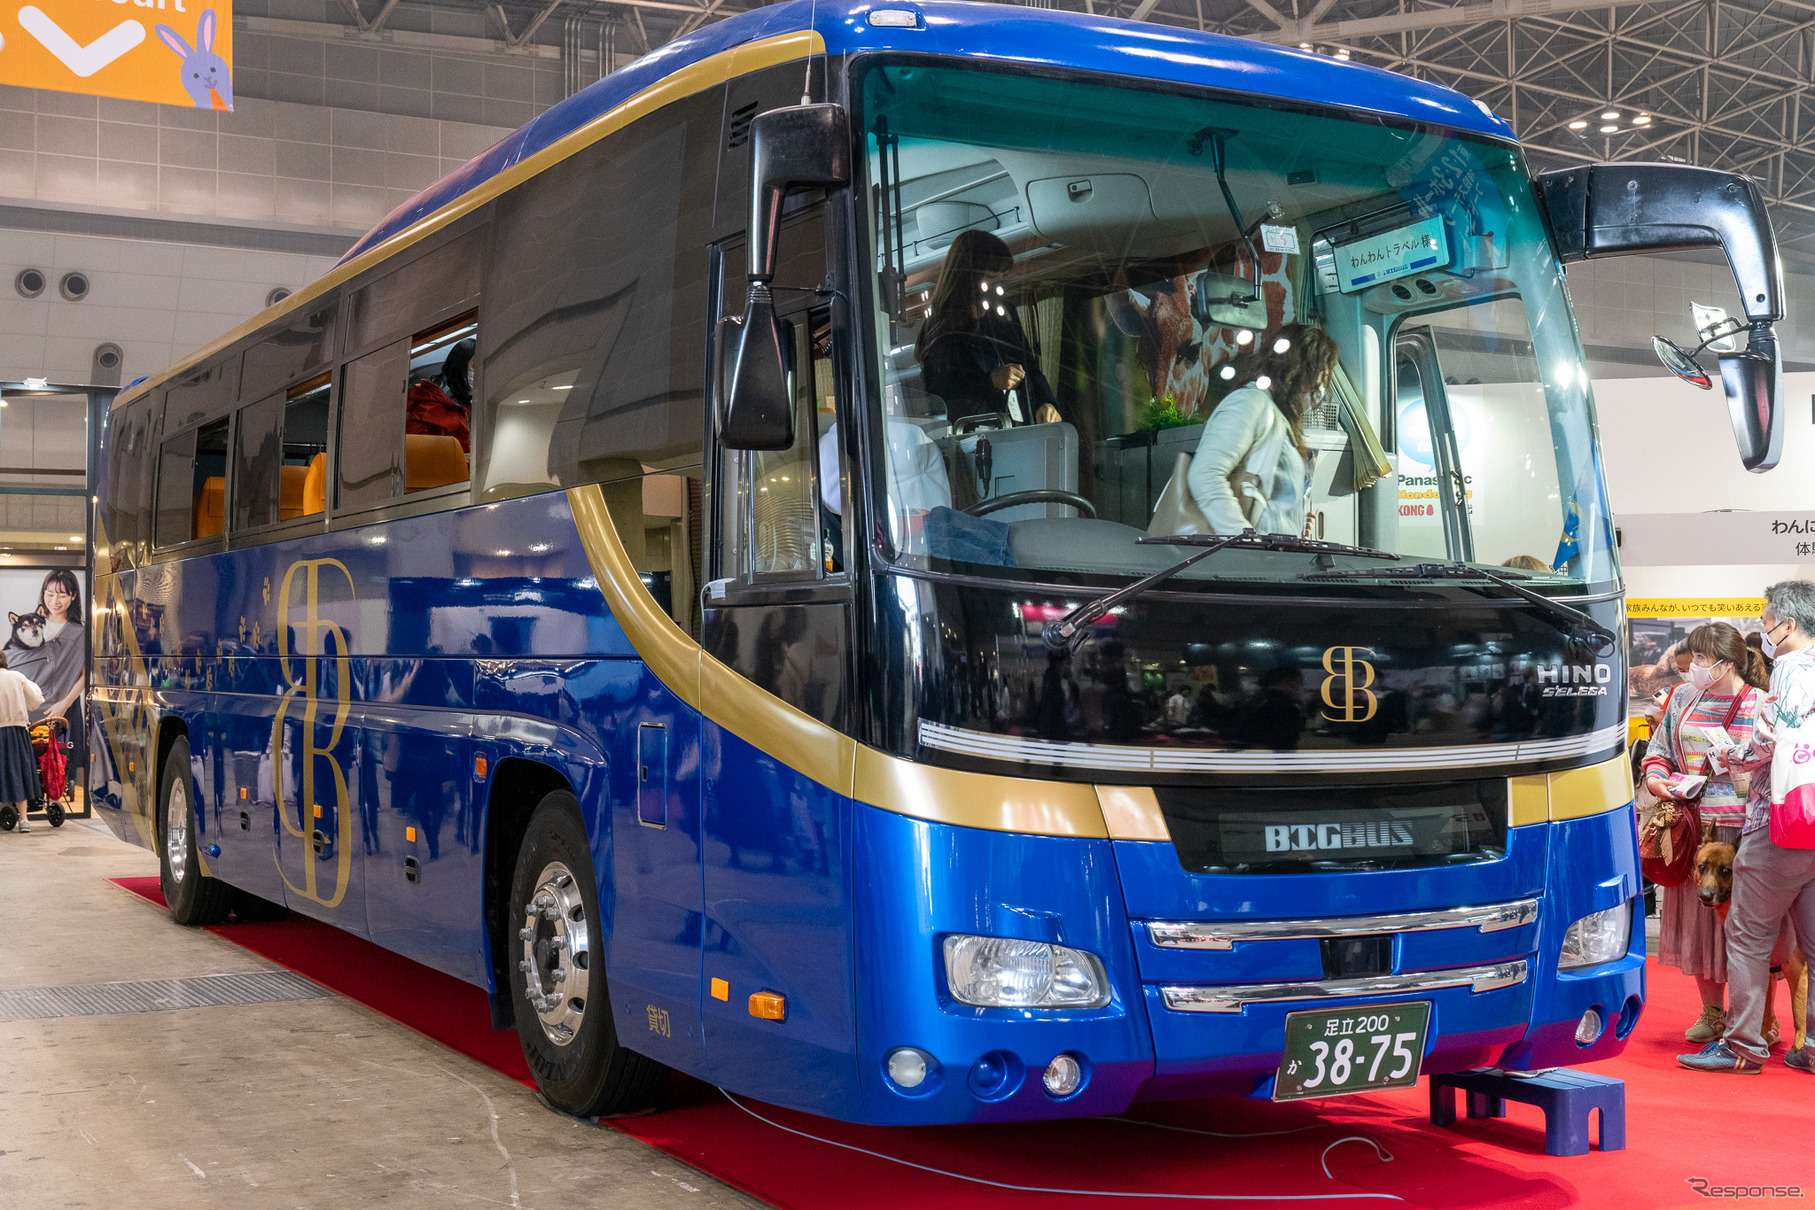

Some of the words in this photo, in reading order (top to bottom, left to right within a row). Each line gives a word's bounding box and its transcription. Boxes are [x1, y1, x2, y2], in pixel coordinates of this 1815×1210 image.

[1398, 474, 1472, 486] Panasc
[1537, 664, 1611, 683] HINO
[646, 1004, 671, 1038] 貸切
[1287, 1059, 1302, 1075] か
[1303, 1032, 1417, 1088] 38-75
